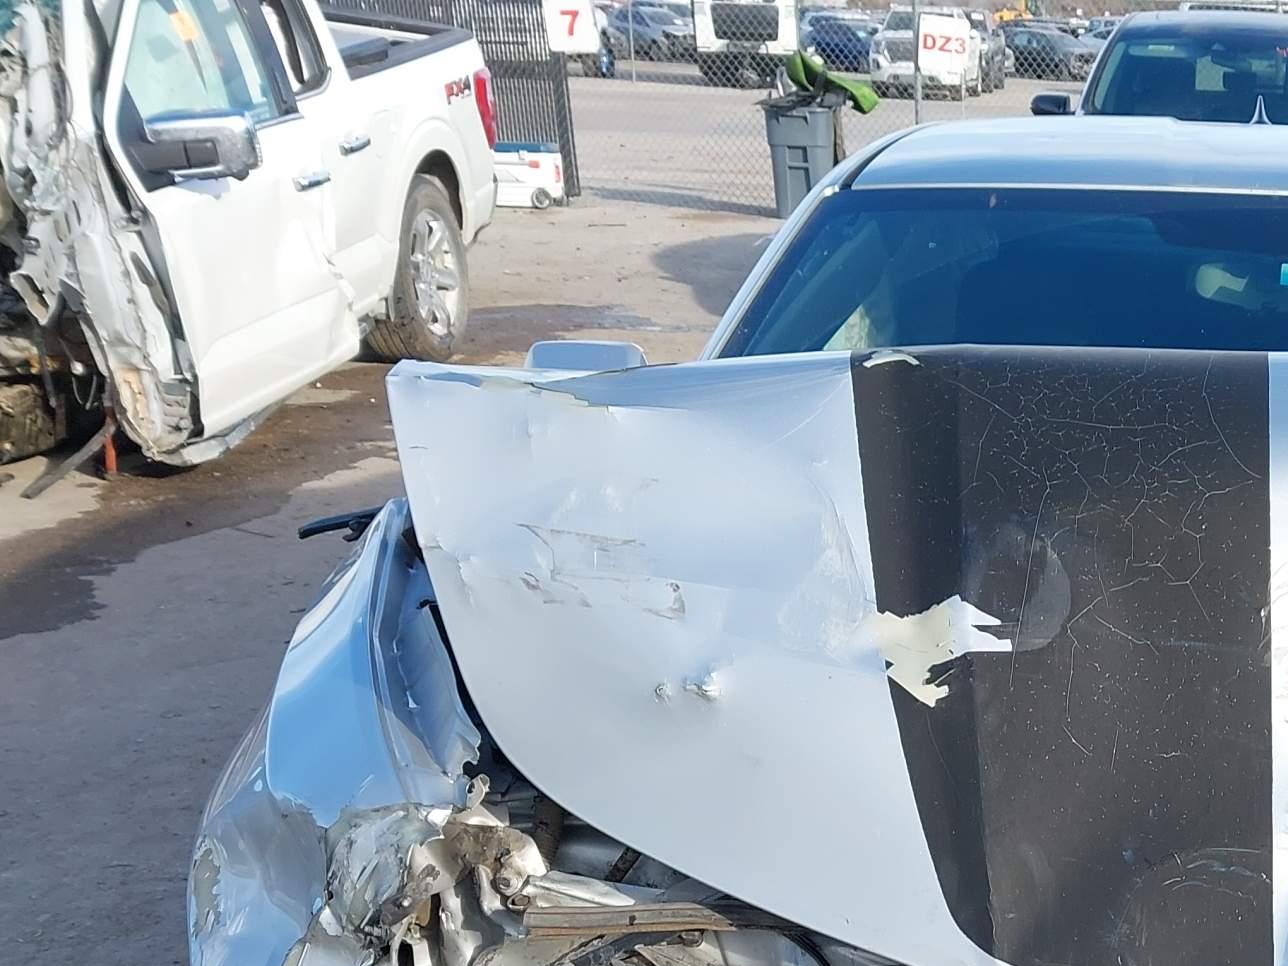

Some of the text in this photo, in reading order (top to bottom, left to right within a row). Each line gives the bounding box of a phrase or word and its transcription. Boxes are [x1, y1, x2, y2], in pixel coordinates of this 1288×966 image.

[559, 10, 579, 36] 7
[923, 34, 966, 54] DZ3
[445, 75, 471, 104] FX4
